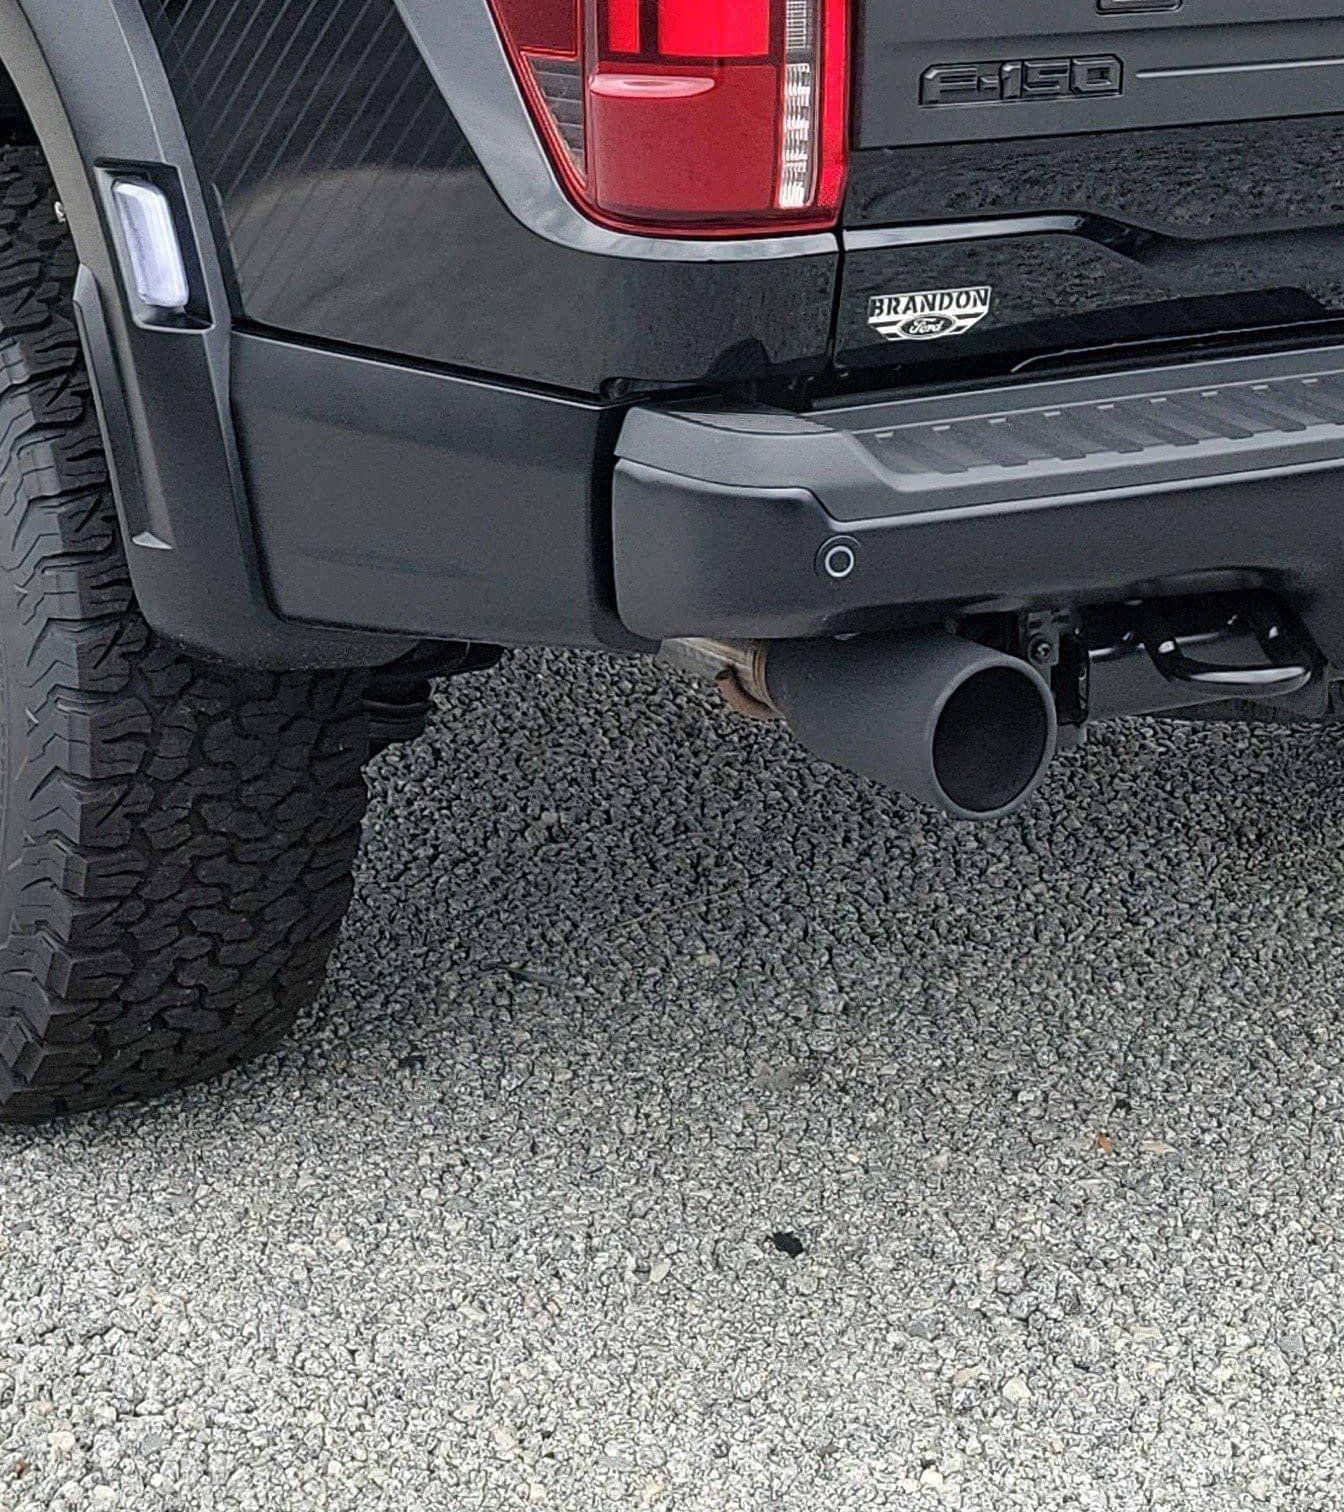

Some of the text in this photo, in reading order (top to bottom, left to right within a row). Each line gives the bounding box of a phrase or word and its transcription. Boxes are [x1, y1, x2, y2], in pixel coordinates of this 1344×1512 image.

[919, 54, 1123, 105] F-150
[869, 288, 989, 317] BRANDON
[909, 318, 944, 334] Ford
